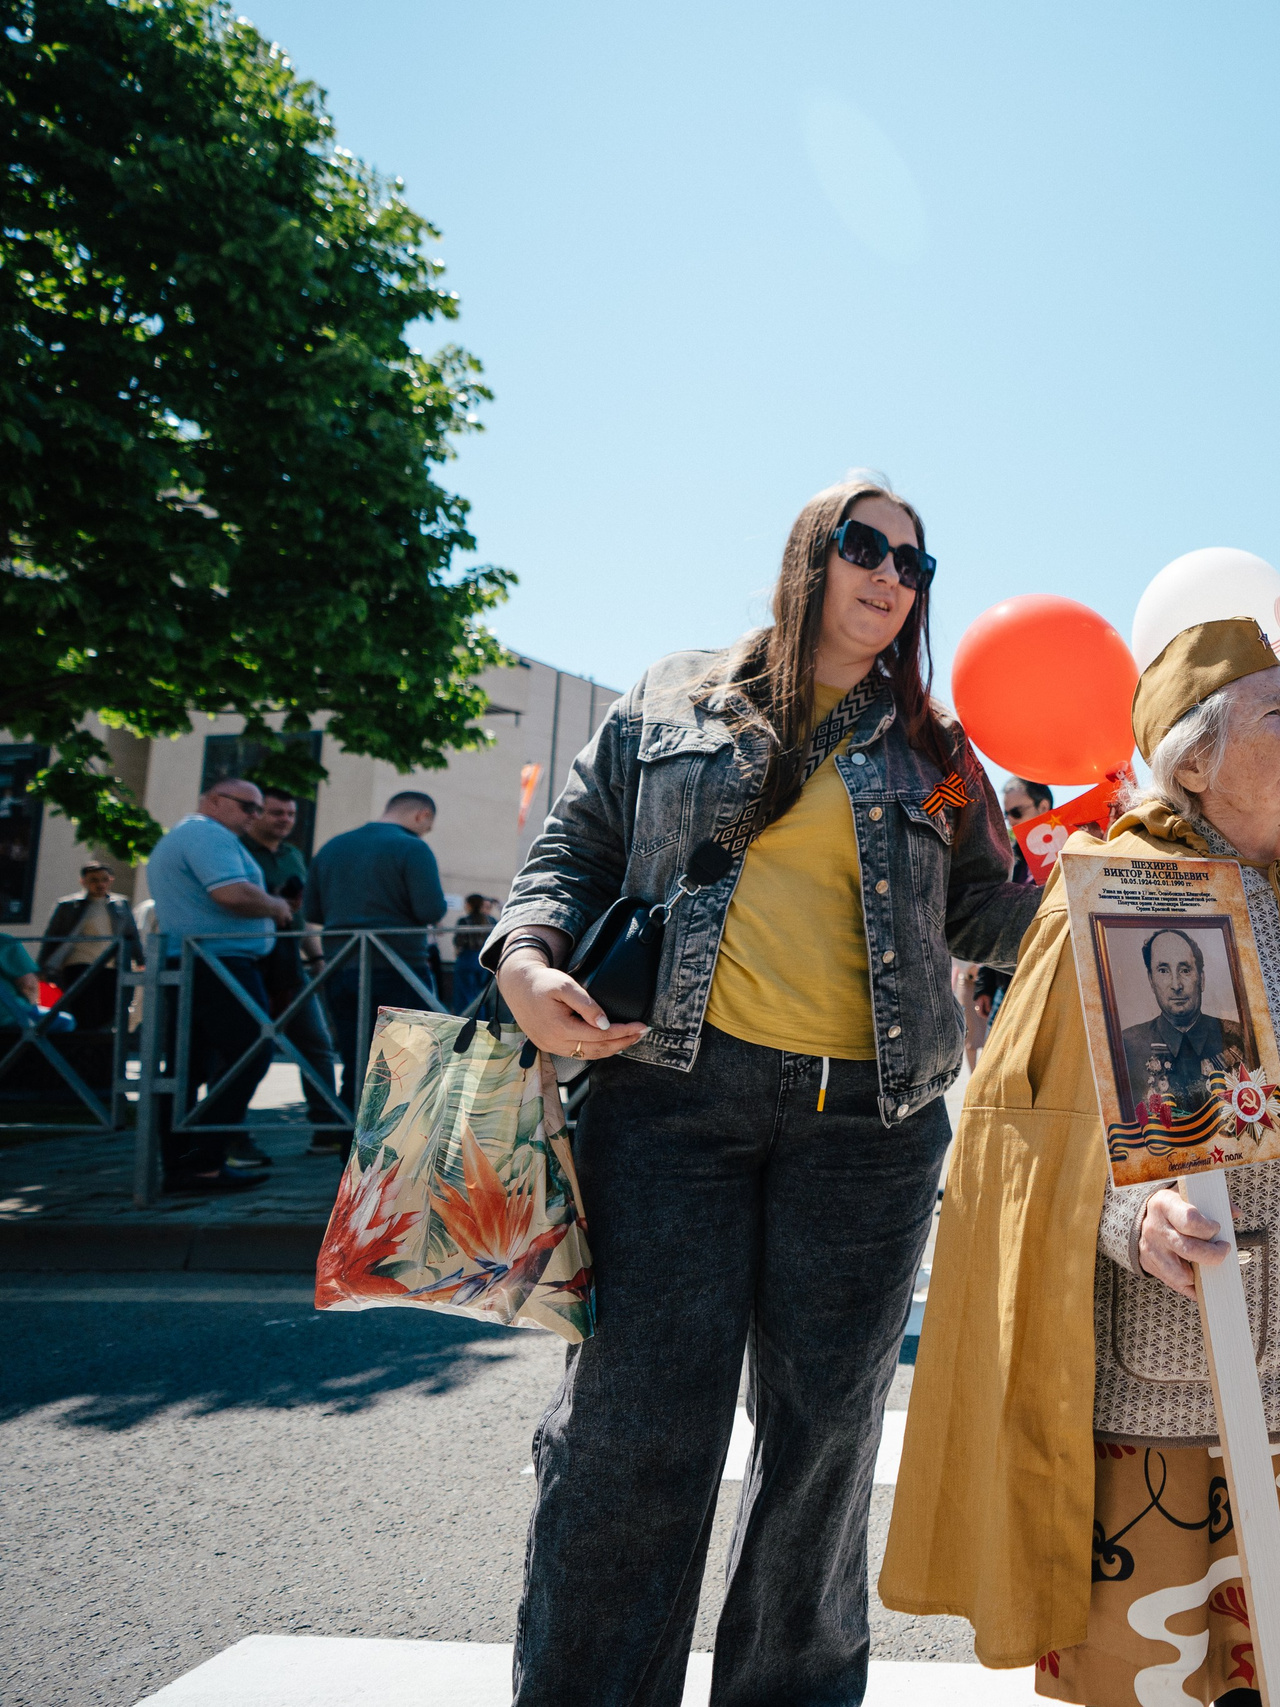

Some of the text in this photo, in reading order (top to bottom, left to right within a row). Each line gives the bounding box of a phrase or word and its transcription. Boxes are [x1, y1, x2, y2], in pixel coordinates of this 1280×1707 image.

[1026, 822, 1068, 868] 9
[1131, 861, 1178, 870] ШЕХИРЕВ
[1103, 868, 1209, 881] ВИКТОР ВАСИЛЬЕВИЧ
